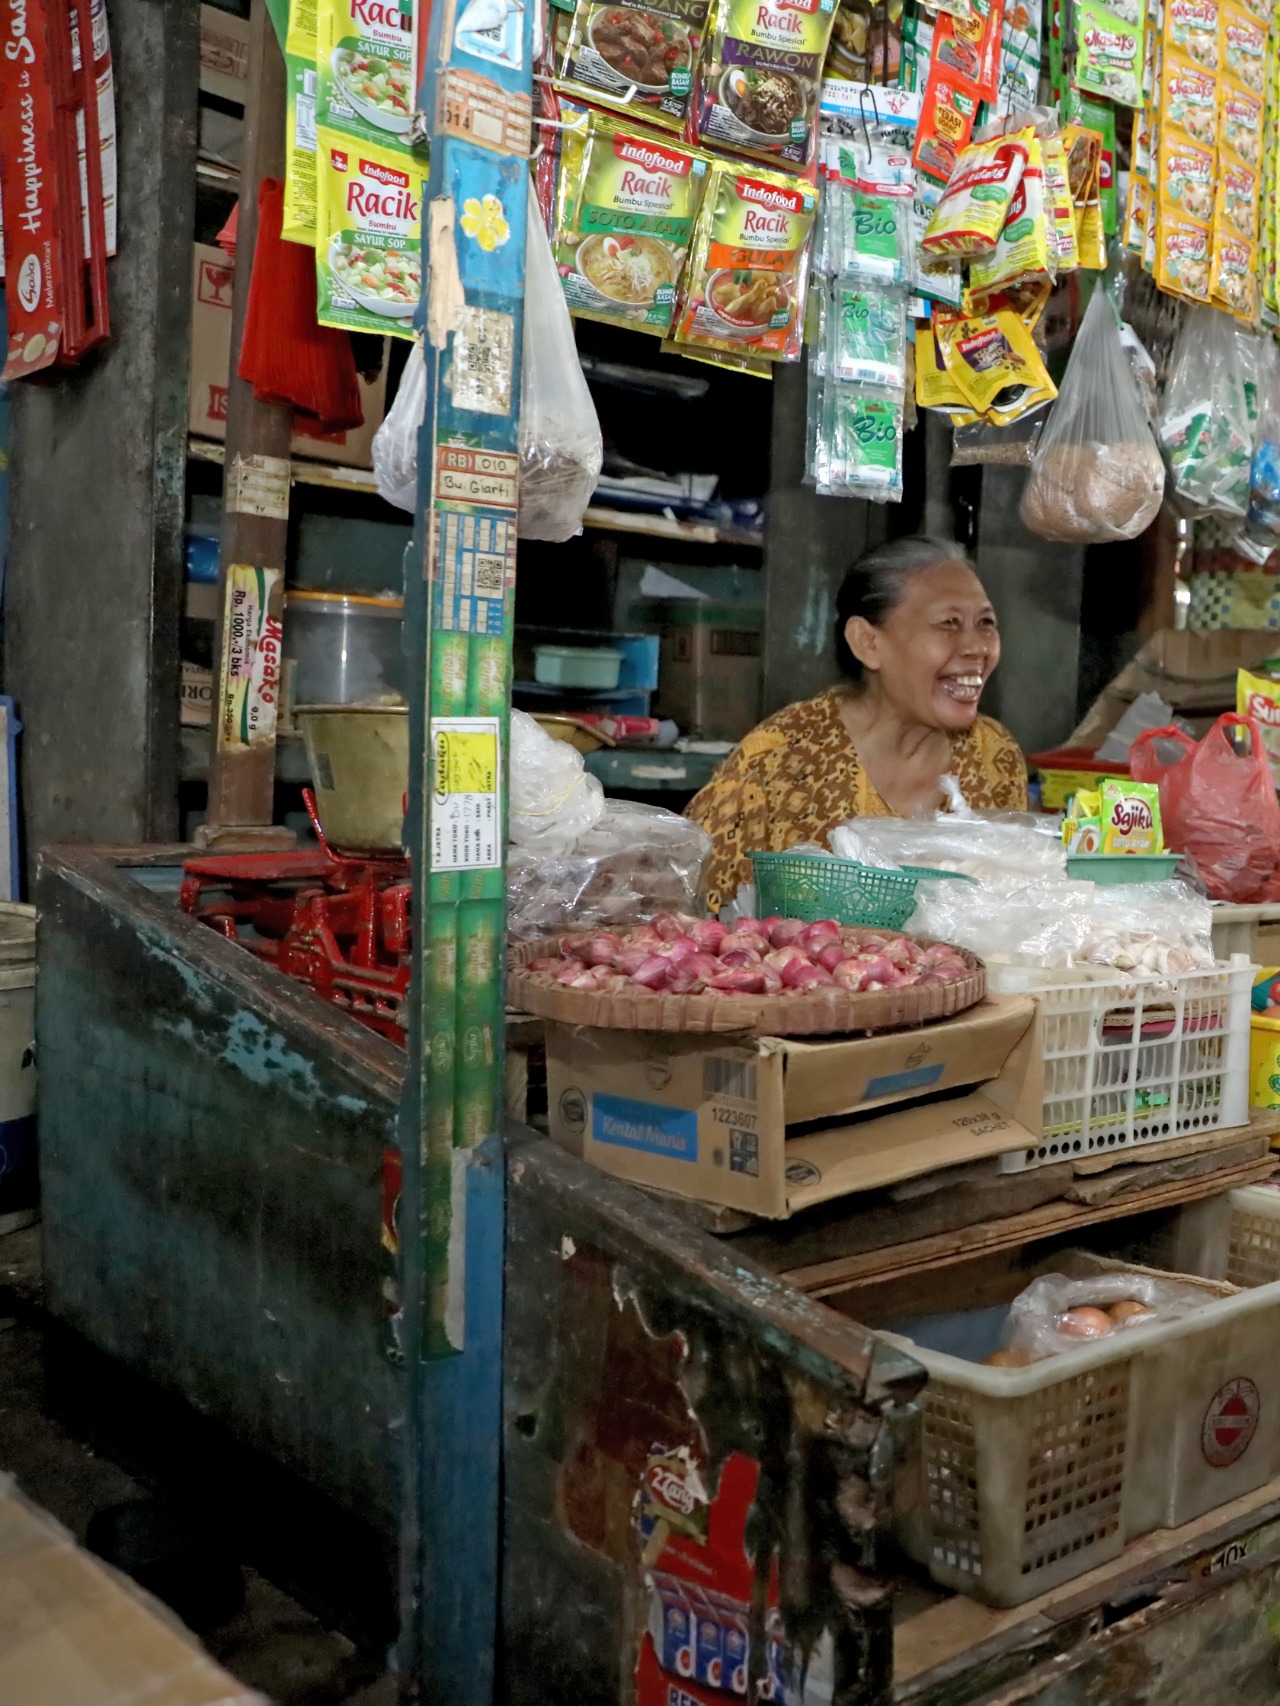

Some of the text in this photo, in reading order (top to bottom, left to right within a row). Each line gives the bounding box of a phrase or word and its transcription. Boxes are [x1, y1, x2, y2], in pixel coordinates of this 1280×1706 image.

[756, 5, 803, 34] Racik
[751, 28, 777, 40] Bumbu
[1084, 28, 1135, 52] Masako
[358, 40, 411, 61] SAYUR SOP
[735, 43, 814, 69] RAWON
[18, 70, 30, 89] is
[938, 107, 962, 127] TERASI
[938, 116, 957, 134] UDANG
[18, 93, 41, 233] Happiness
[620, 141, 685, 174] Indofood
[363, 163, 406, 186] Indofood
[620, 170, 673, 199] Racik
[347, 180, 418, 221] Racik
[613, 195, 642, 207] Bumbu
[742, 183, 797, 210] Indofood
[368, 219, 397, 231] Bumbu
[587, 209, 636, 230] SOTO
[639, 217, 690, 238] AYAM
[743, 210, 789, 234] Racik
[852, 210, 897, 236] Bio
[354, 233, 406, 249] SAYUR SOP
[739, 232, 764, 243] Bumbu
[20, 261, 36, 304] Sasa
[842, 301, 869, 320] Bio
[853, 415, 897, 444] Bio
[441, 450, 506, 471] (RB) 010
[234, 590, 246, 608] Rp.
[244, 604, 254, 665] Harga Ekonomis
[230, 657, 243, 677] bks
[257, 614, 283, 704] Masako
[1111, 800, 1154, 836] Sajiku
[1112, 837, 1130, 848] SOTO
[711, 1106, 758, 1130] 1223607
[602, 1113, 688, 1150] Kental Manis
